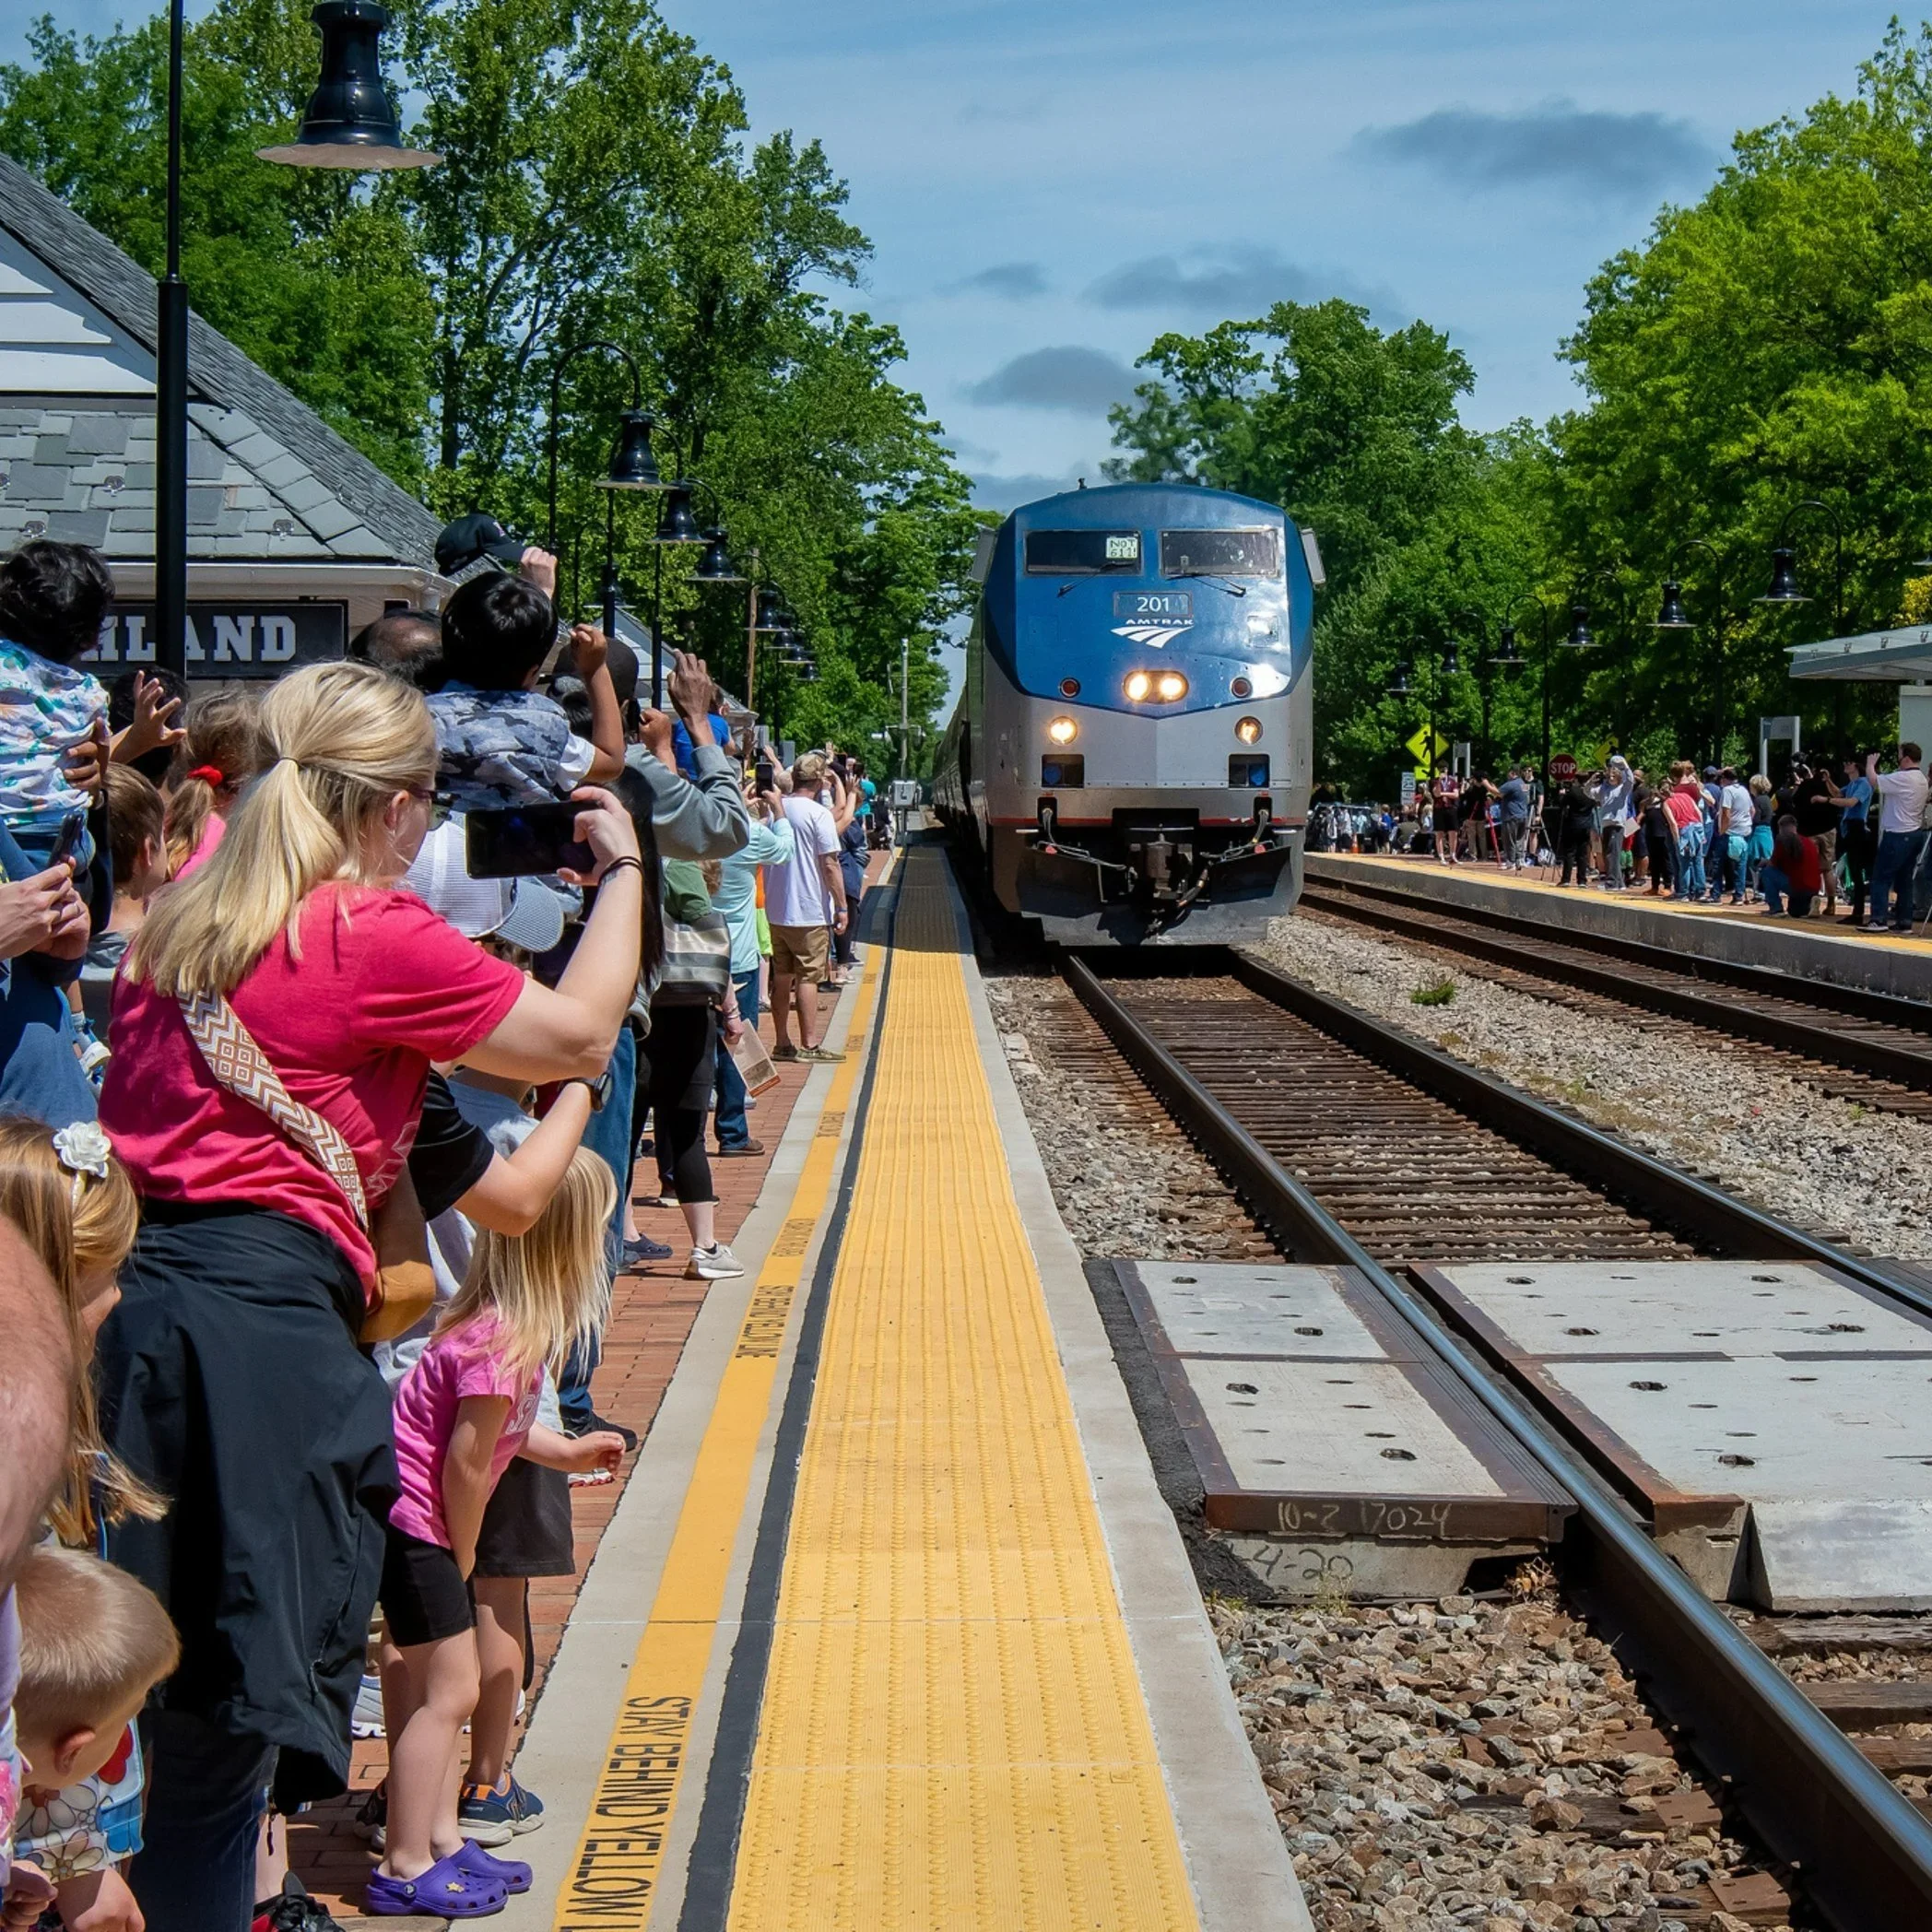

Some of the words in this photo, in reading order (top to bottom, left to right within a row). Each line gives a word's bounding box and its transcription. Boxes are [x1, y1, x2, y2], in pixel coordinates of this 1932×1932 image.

[1110, 538, 1136, 548] NOT
[1137, 596, 1170, 613] 201
[1550, 762, 1576, 774] STOP
[618, 1696, 692, 1738] STAY
[595, 1743, 683, 1818] BEHIND
[565, 1821, 665, 1917] YELLOW
